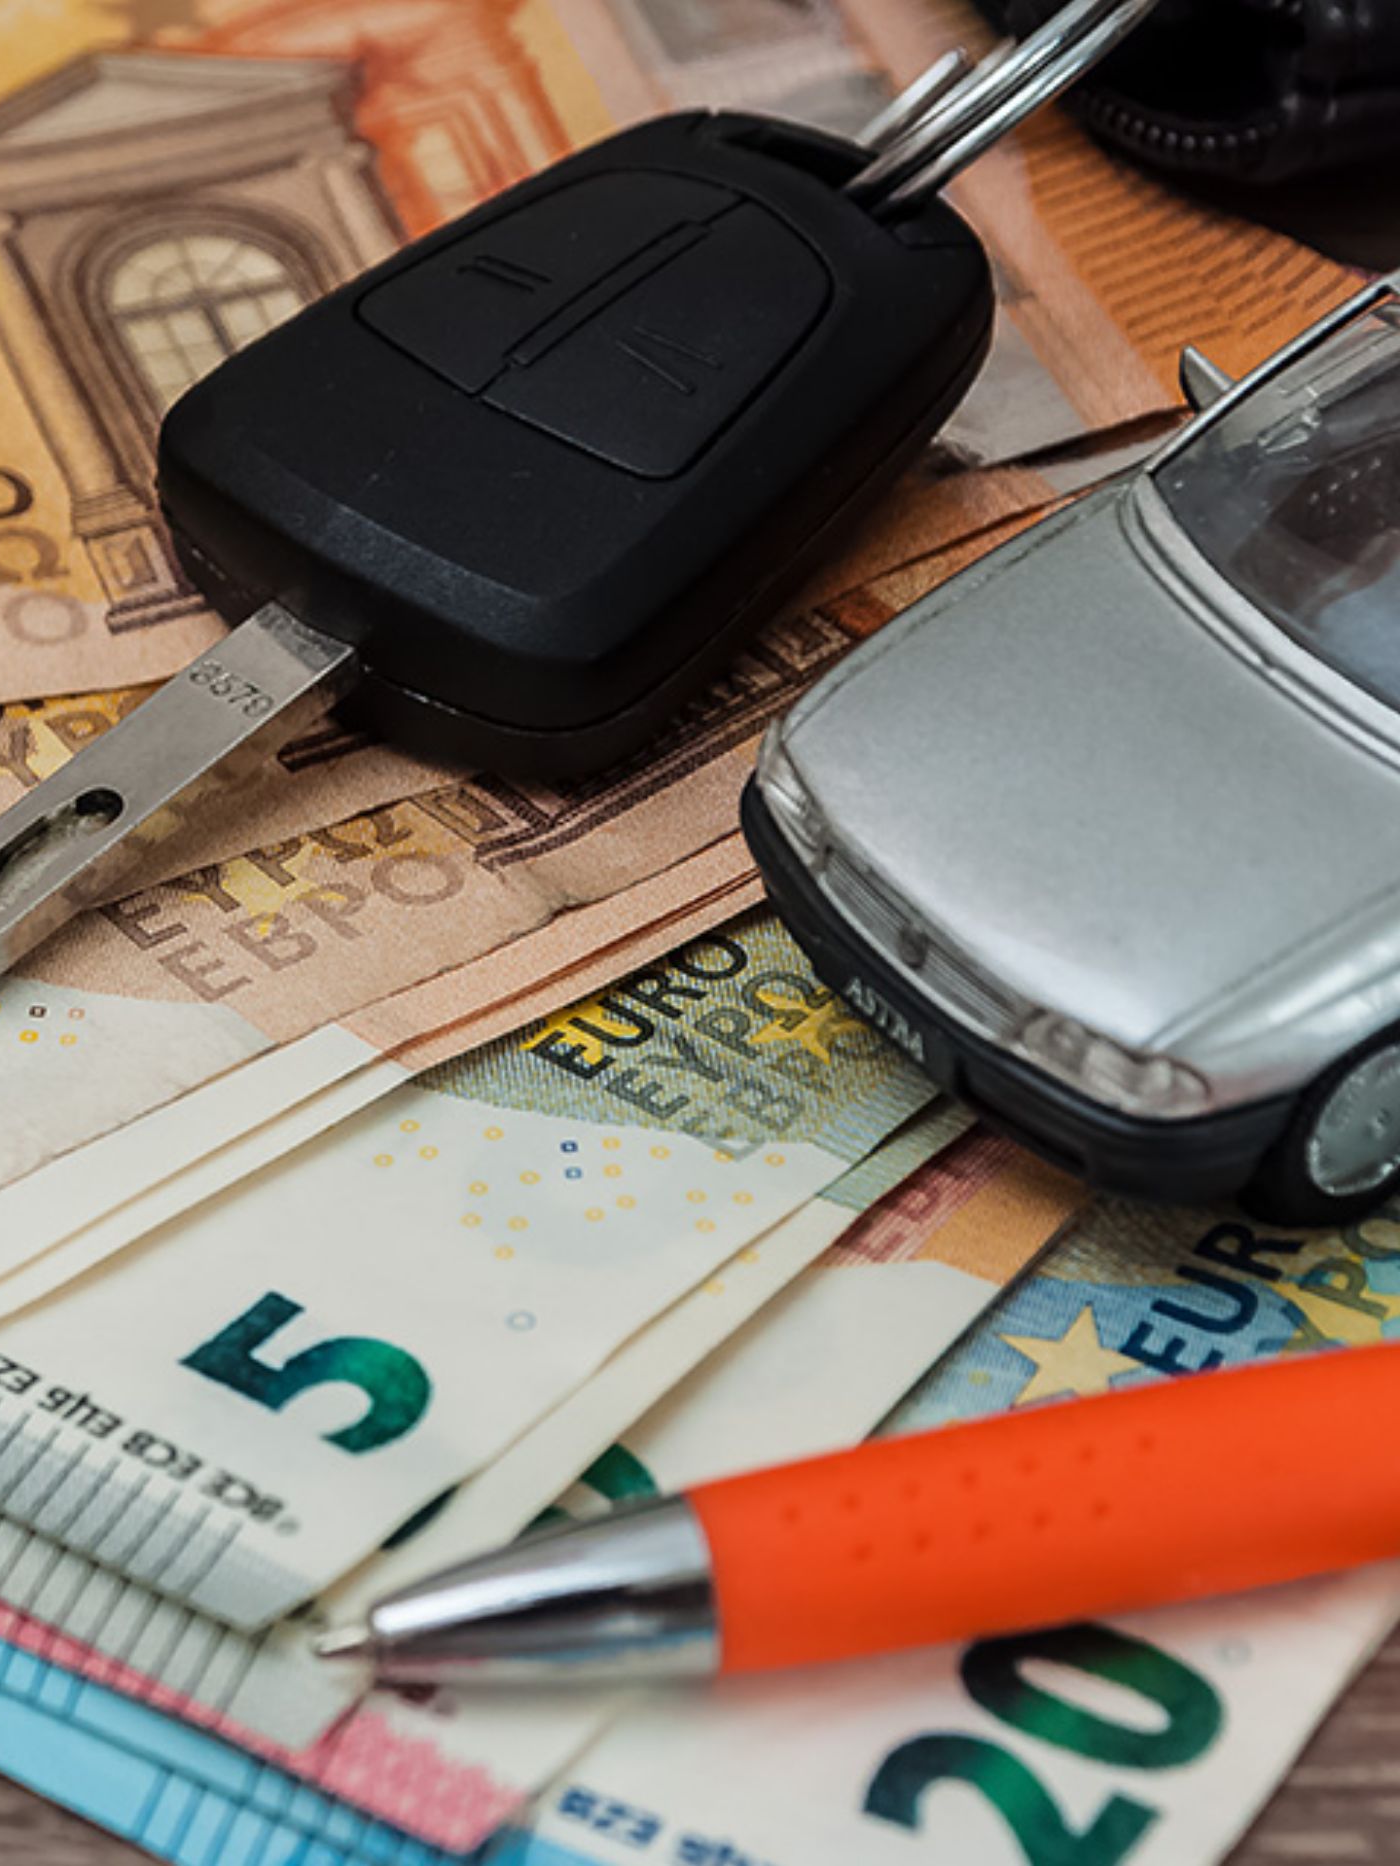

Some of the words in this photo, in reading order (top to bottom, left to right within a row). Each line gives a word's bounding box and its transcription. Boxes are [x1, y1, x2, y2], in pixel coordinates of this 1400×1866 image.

[531, 934, 748, 1081] EURO
[844, 977, 925, 1063] ASTRA
[179, 1290, 433, 1456] 5
[1119, 1222, 1306, 1378] EUR
[863, 1621, 1225, 1866] 20
